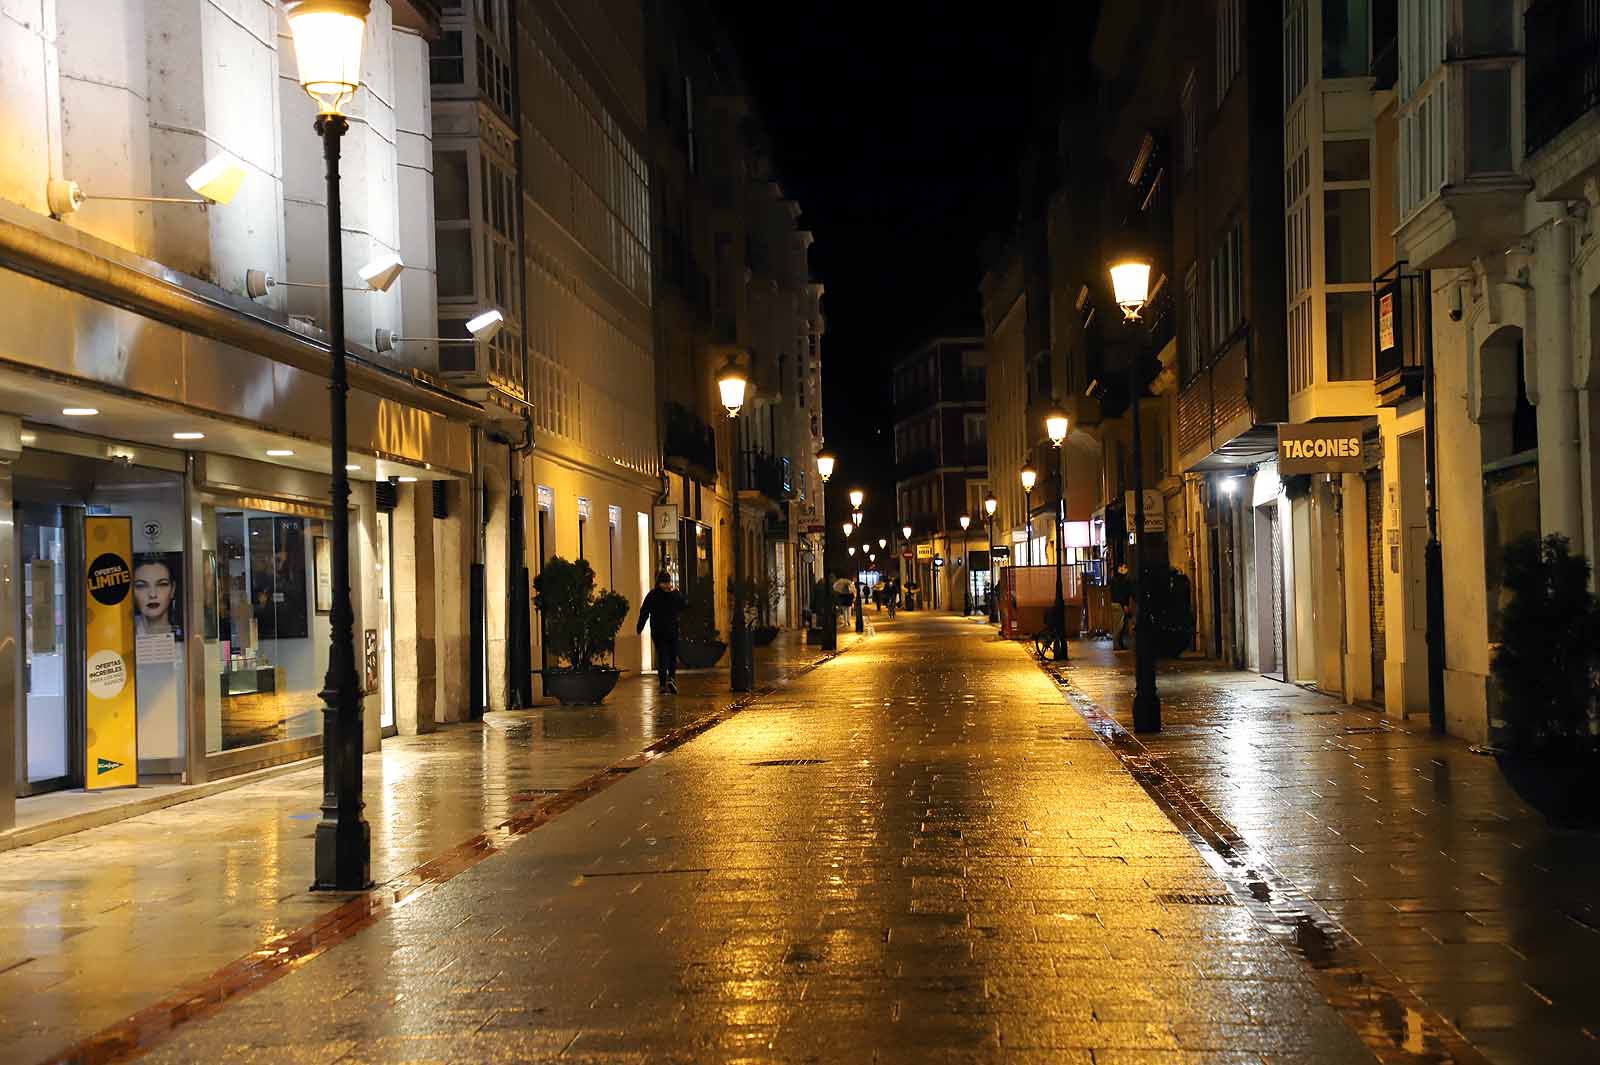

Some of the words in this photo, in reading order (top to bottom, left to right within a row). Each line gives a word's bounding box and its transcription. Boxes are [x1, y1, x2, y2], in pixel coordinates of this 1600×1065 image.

[1282, 438, 1360, 458] TACONES
[94, 565, 122, 577] OFERTAS
[88, 570, 130, 589] LIMITE
[96, 660, 121, 670] OFERTAS
